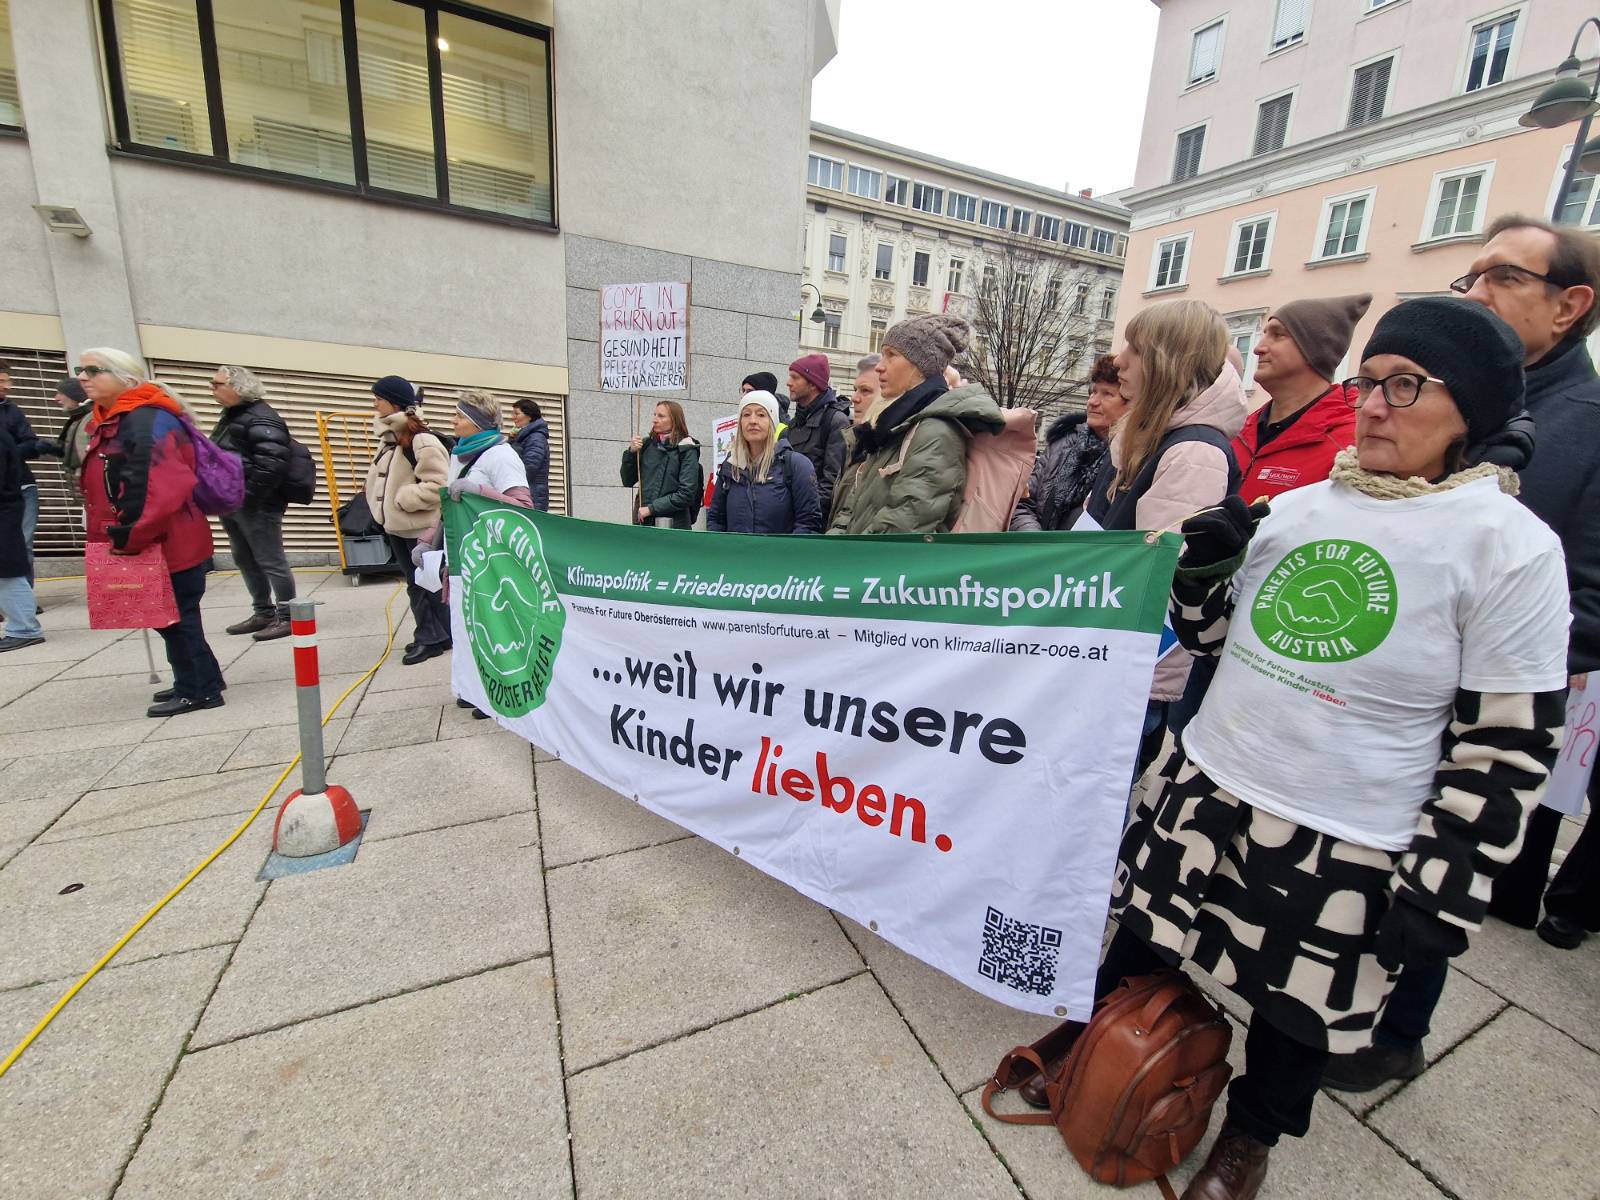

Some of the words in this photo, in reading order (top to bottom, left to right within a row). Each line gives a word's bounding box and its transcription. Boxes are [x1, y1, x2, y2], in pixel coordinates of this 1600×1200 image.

[602, 284, 646, 310] COME
[657, 284, 673, 310] IN
[614, 309, 653, 331] BURN
[656, 311, 677, 330] OUT
[603, 336, 681, 358] GESUNDHEIT
[604, 360, 638, 374] PFLEGE
[649, 361, 686, 375] SOZIALES
[602, 373, 685, 388] AUSFINANZIEREN
[509, 526, 561, 614] FUTURE
[1256, 552, 1306, 610] PARENTS
[1315, 543, 1351, 560] FOR
[1352, 551, 1391, 615] FUTURE
[567, 565, 652, 593] Klimapolitik
[672, 573, 825, 605] Friedenspolitik
[861, 572, 1125, 617] Zukunftspolitik
[595, 606, 607, 617] For
[608, 608, 632, 621] Future
[634, 611, 697, 628] Oberösterreich
[702, 620, 830, 640] www.parentsforfuture.at
[854, 629, 907, 648] Mitglied
[911, 636, 939, 649] von
[945, 636, 1109, 661] klimaallianz-ooe.at
[1268, 630, 1358, 658] AUSTRIA
[477, 634, 556, 709] ERÖSTERREICH
[1254, 653, 1268, 664] For
[1267, 660, 1296, 678] Future
[1297, 674, 1336, 694] Austria
[1277, 675, 1311, 694] Kinder
[1312, 689, 1347, 707] lieben
[713, 662, 785, 717] wir
[803, 688, 1027, 765] unsere
[610, 704, 743, 781] Kinder
[752, 736, 953, 852] lieben.
